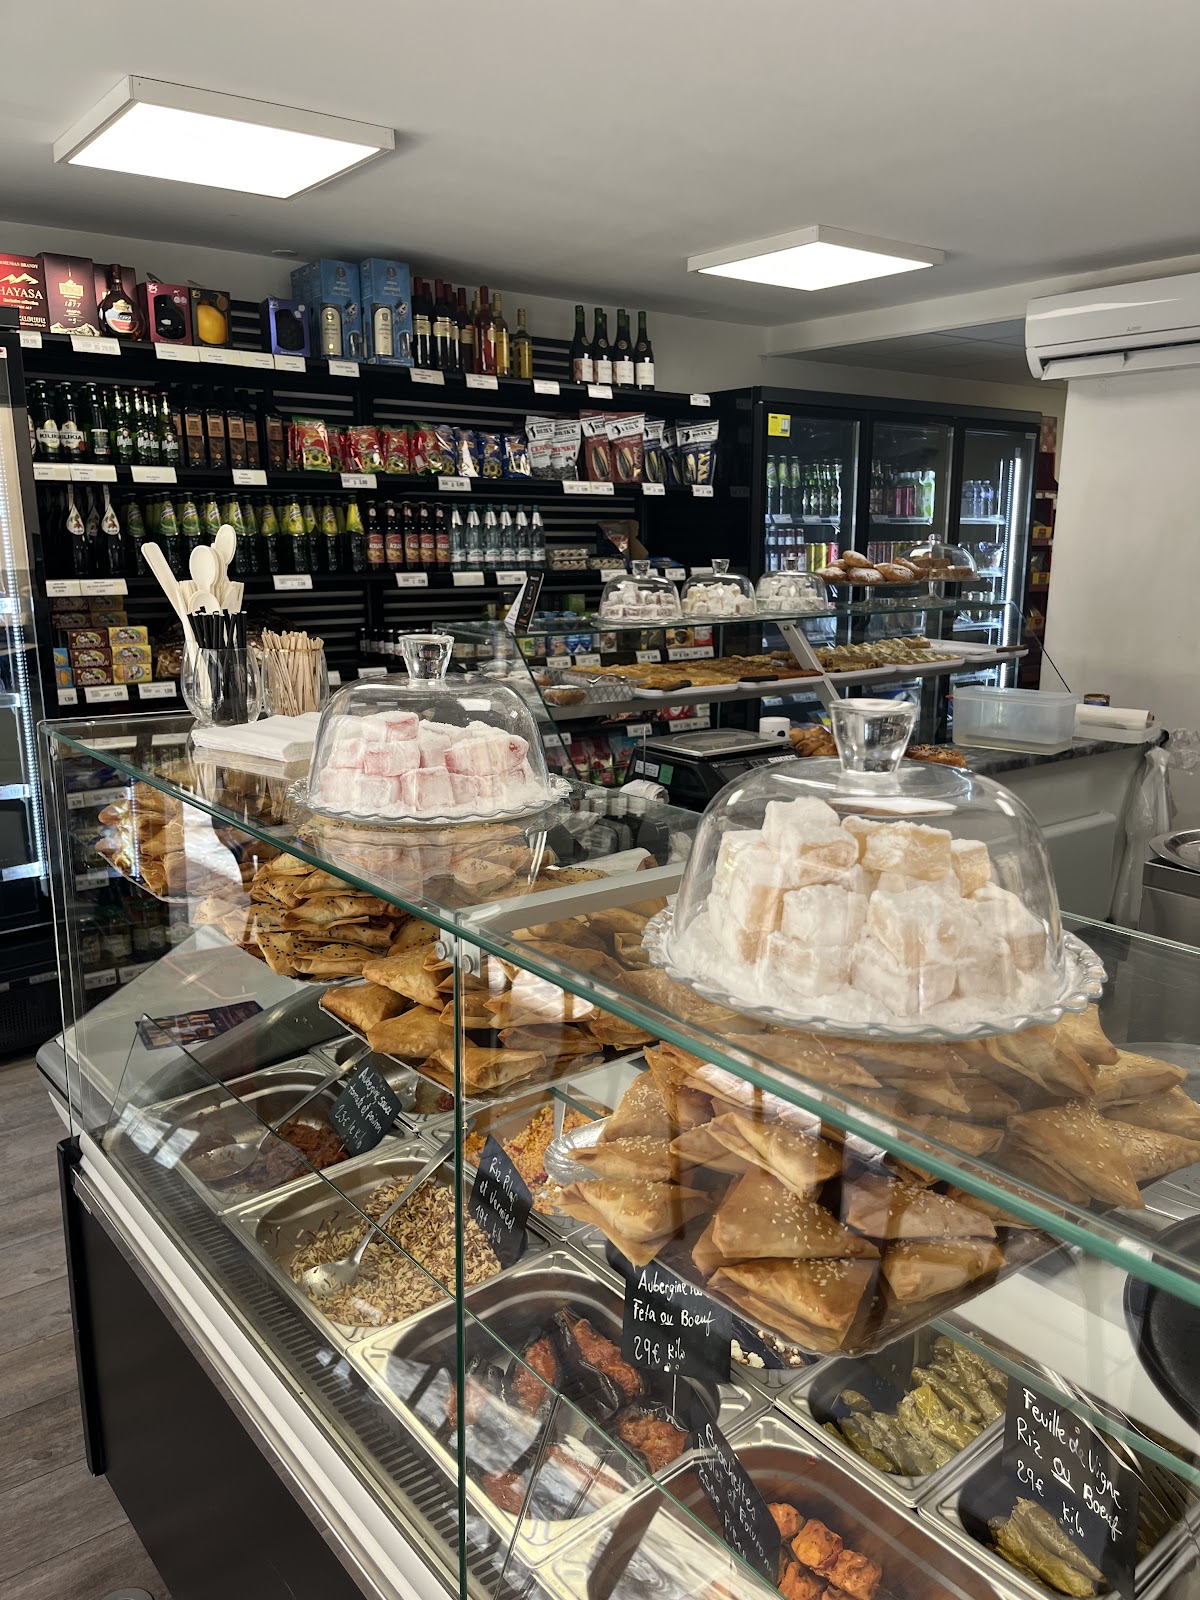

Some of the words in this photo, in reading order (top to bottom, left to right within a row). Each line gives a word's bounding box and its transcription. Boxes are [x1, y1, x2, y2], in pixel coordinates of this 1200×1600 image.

[480, 1180, 489, 1197] et
[637, 1269, 688, 1302] Aubergine
[632, 1298, 657, 1323] Feta
[660, 1311, 674, 1326] ou
[680, 1310, 717, 1337] Boeuf
[633, 1335, 661, 1365] 29€
[1022, 1387, 1066, 1445] Feuille
[705, 1423, 756, 1521] Brochettes
[1016, 1459, 1044, 1497] 29€
[1016, 1416, 1043, 1459] Riz
[1083, 1483, 1123, 1542] Boeuf
[727, 1489, 737, 1512] et
